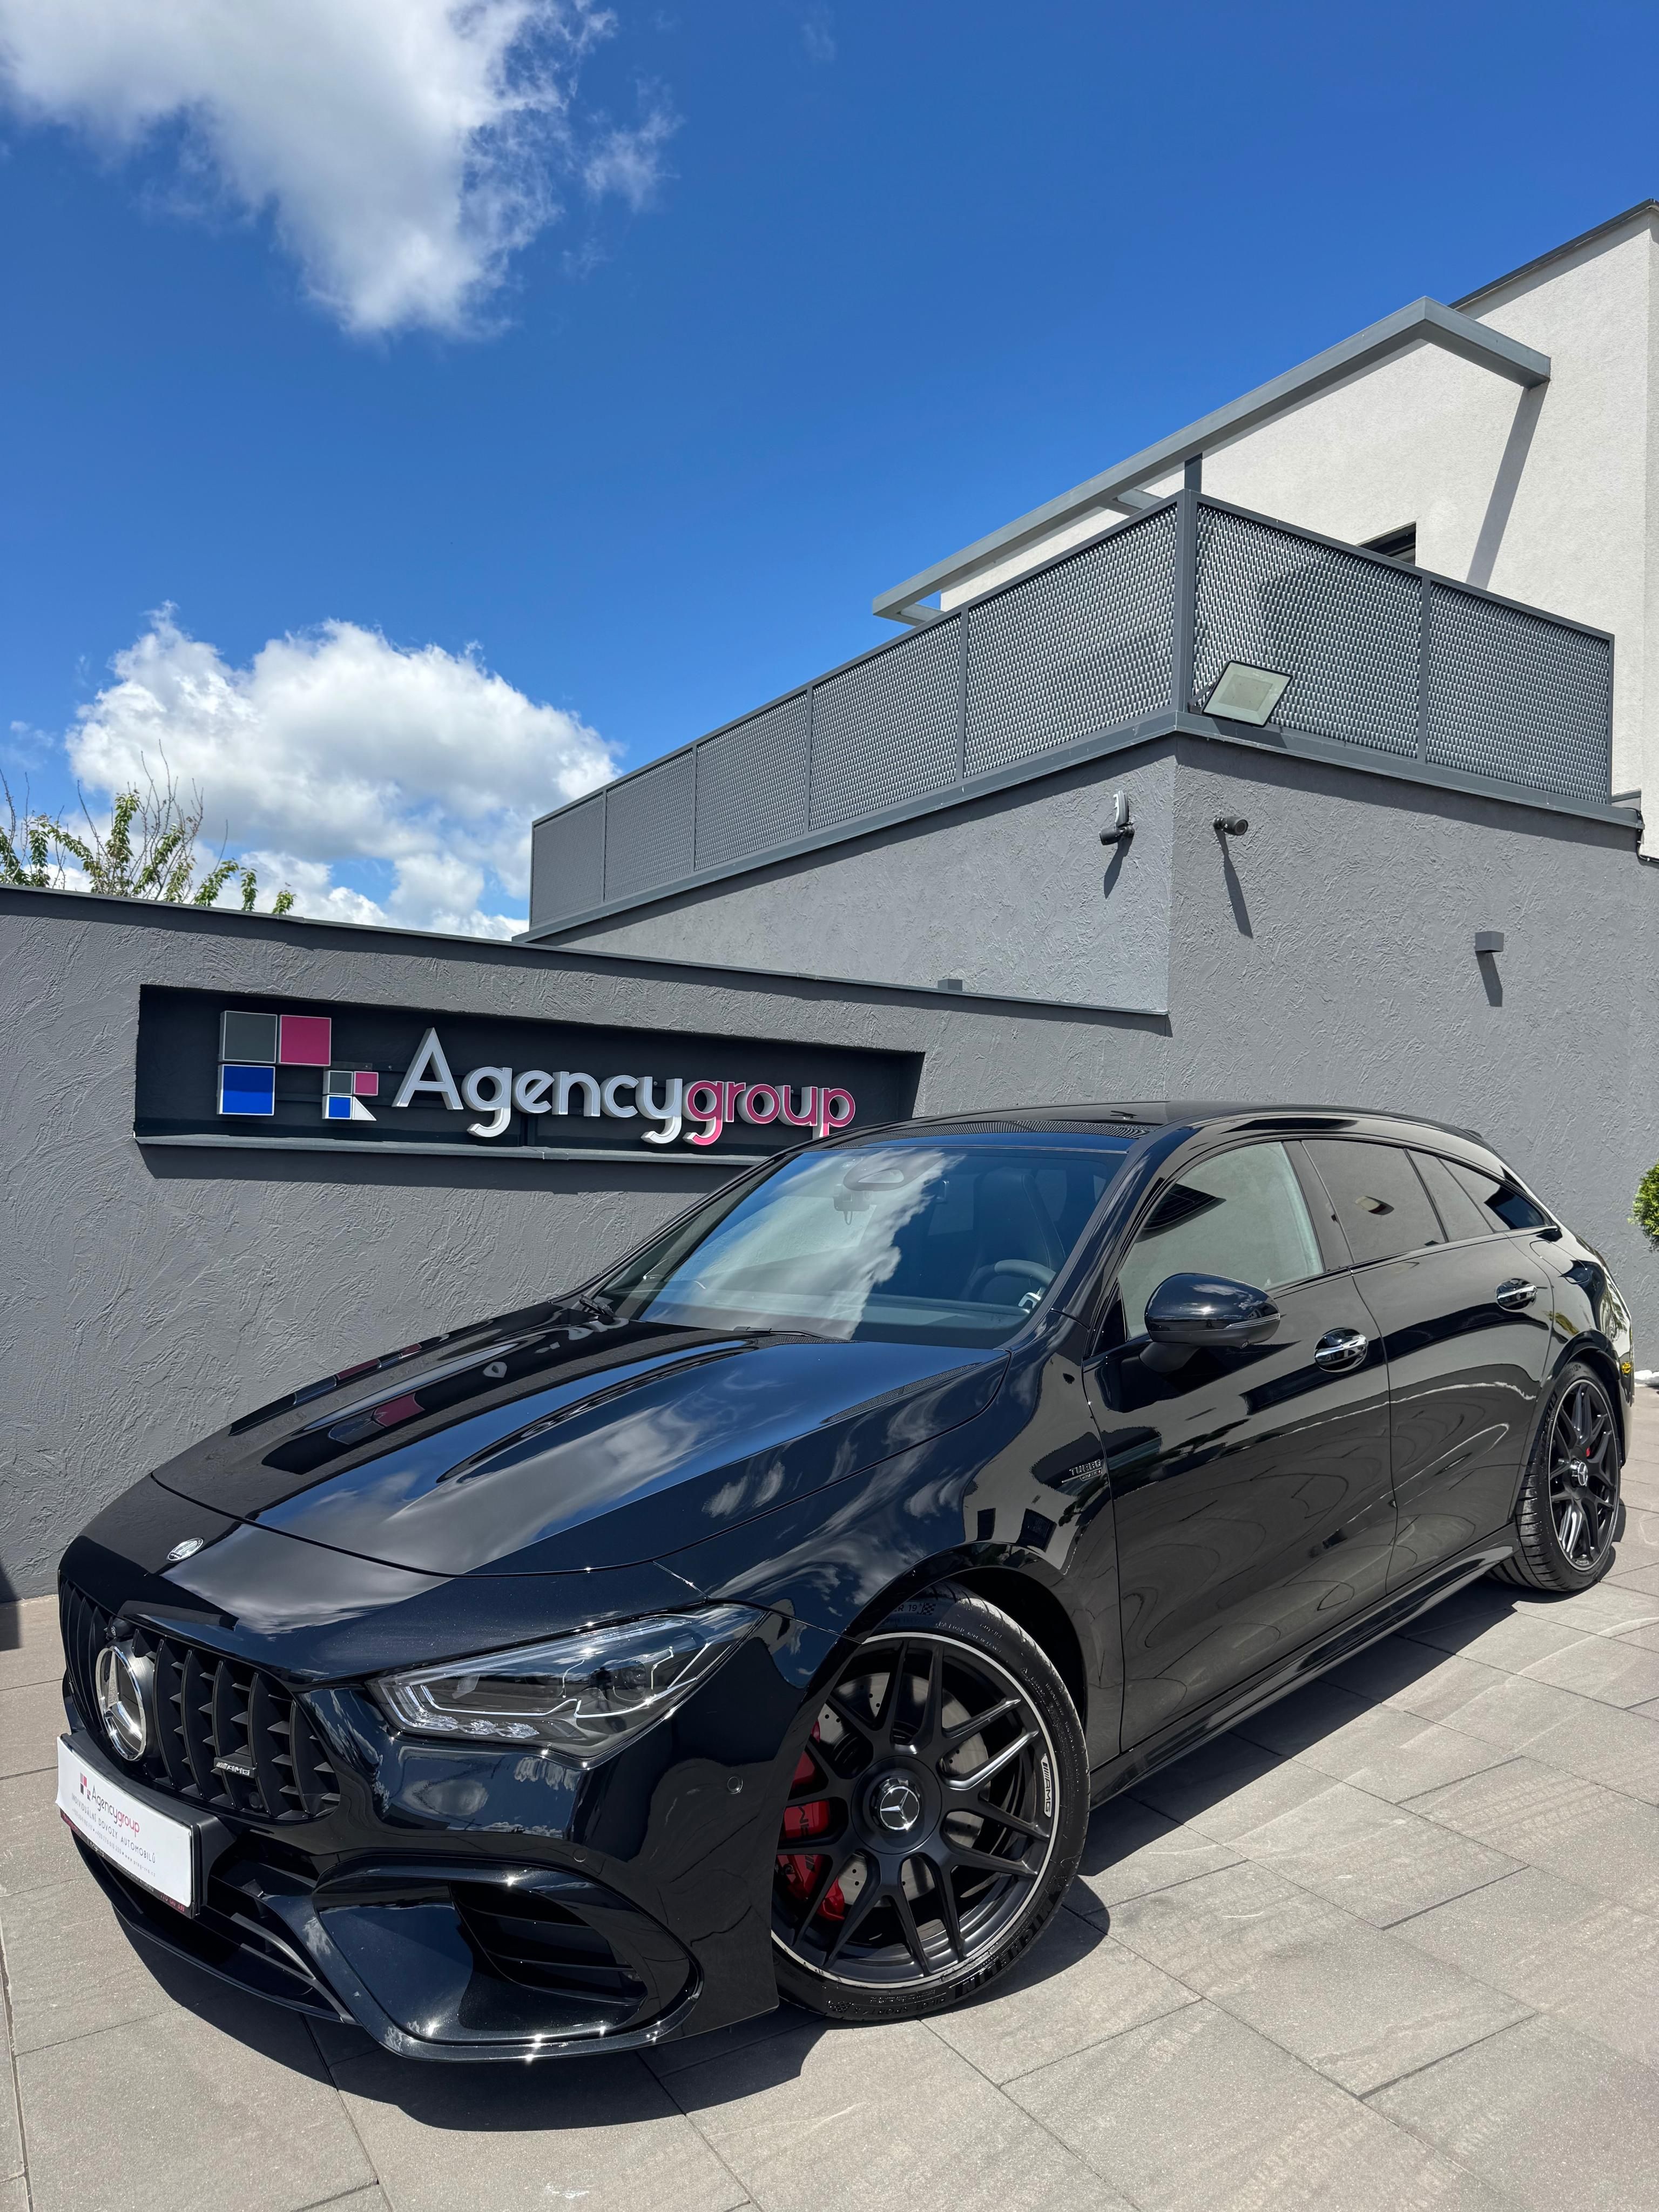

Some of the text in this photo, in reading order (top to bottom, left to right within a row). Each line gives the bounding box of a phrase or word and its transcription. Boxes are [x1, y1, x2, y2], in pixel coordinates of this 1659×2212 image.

[226, 1764, 250, 1776] AMG
[91, 1784, 140, 1838] Agencygroup
[98, 1817, 118, 1839] DOVOZY
[120, 1836, 156, 1863] AUTOMOBILŮ
